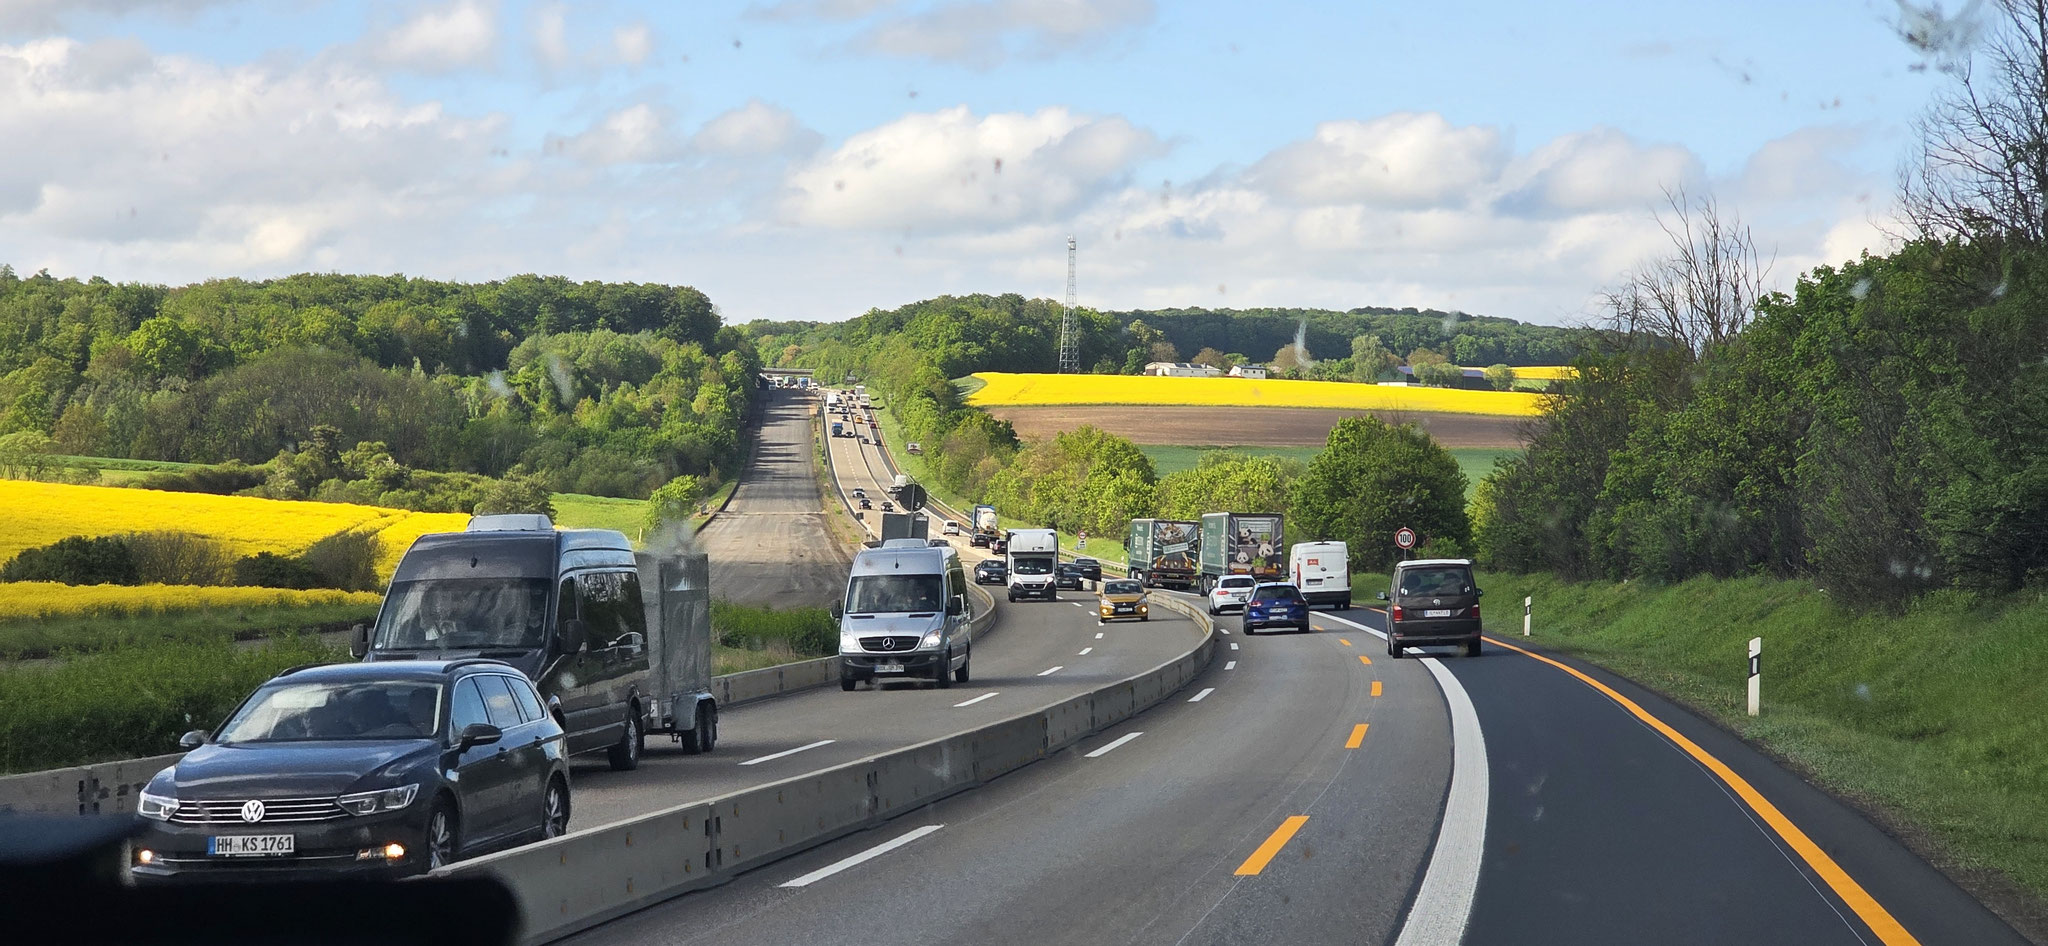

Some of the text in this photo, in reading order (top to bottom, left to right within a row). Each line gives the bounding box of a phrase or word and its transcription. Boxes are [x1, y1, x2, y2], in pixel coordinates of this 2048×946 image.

[1400, 534, 1412, 543] 100
[217, 836, 292, 852] HH KS 1761
